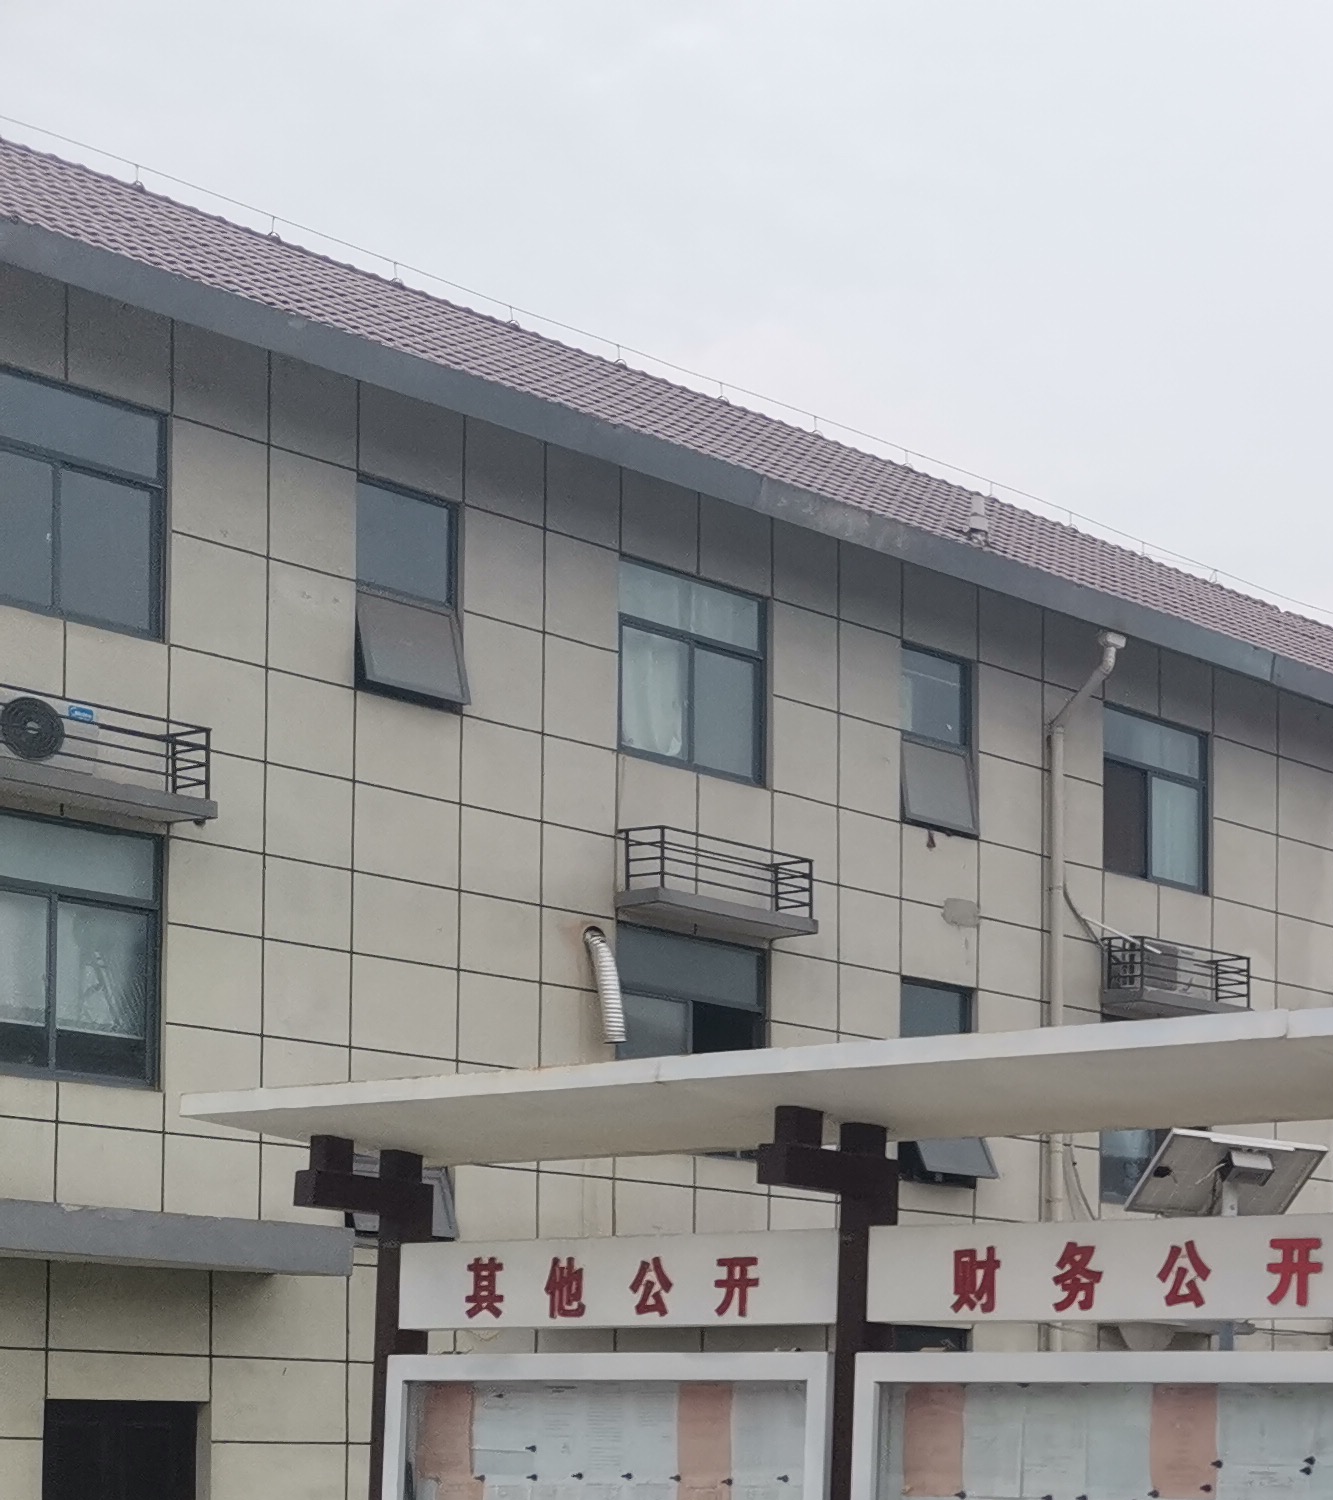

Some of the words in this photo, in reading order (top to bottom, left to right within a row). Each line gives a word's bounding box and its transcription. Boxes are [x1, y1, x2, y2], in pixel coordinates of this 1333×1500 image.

[466, 1257, 759, 1317] 其他公开
[953, 1237, 1323, 1313] 财务公开
